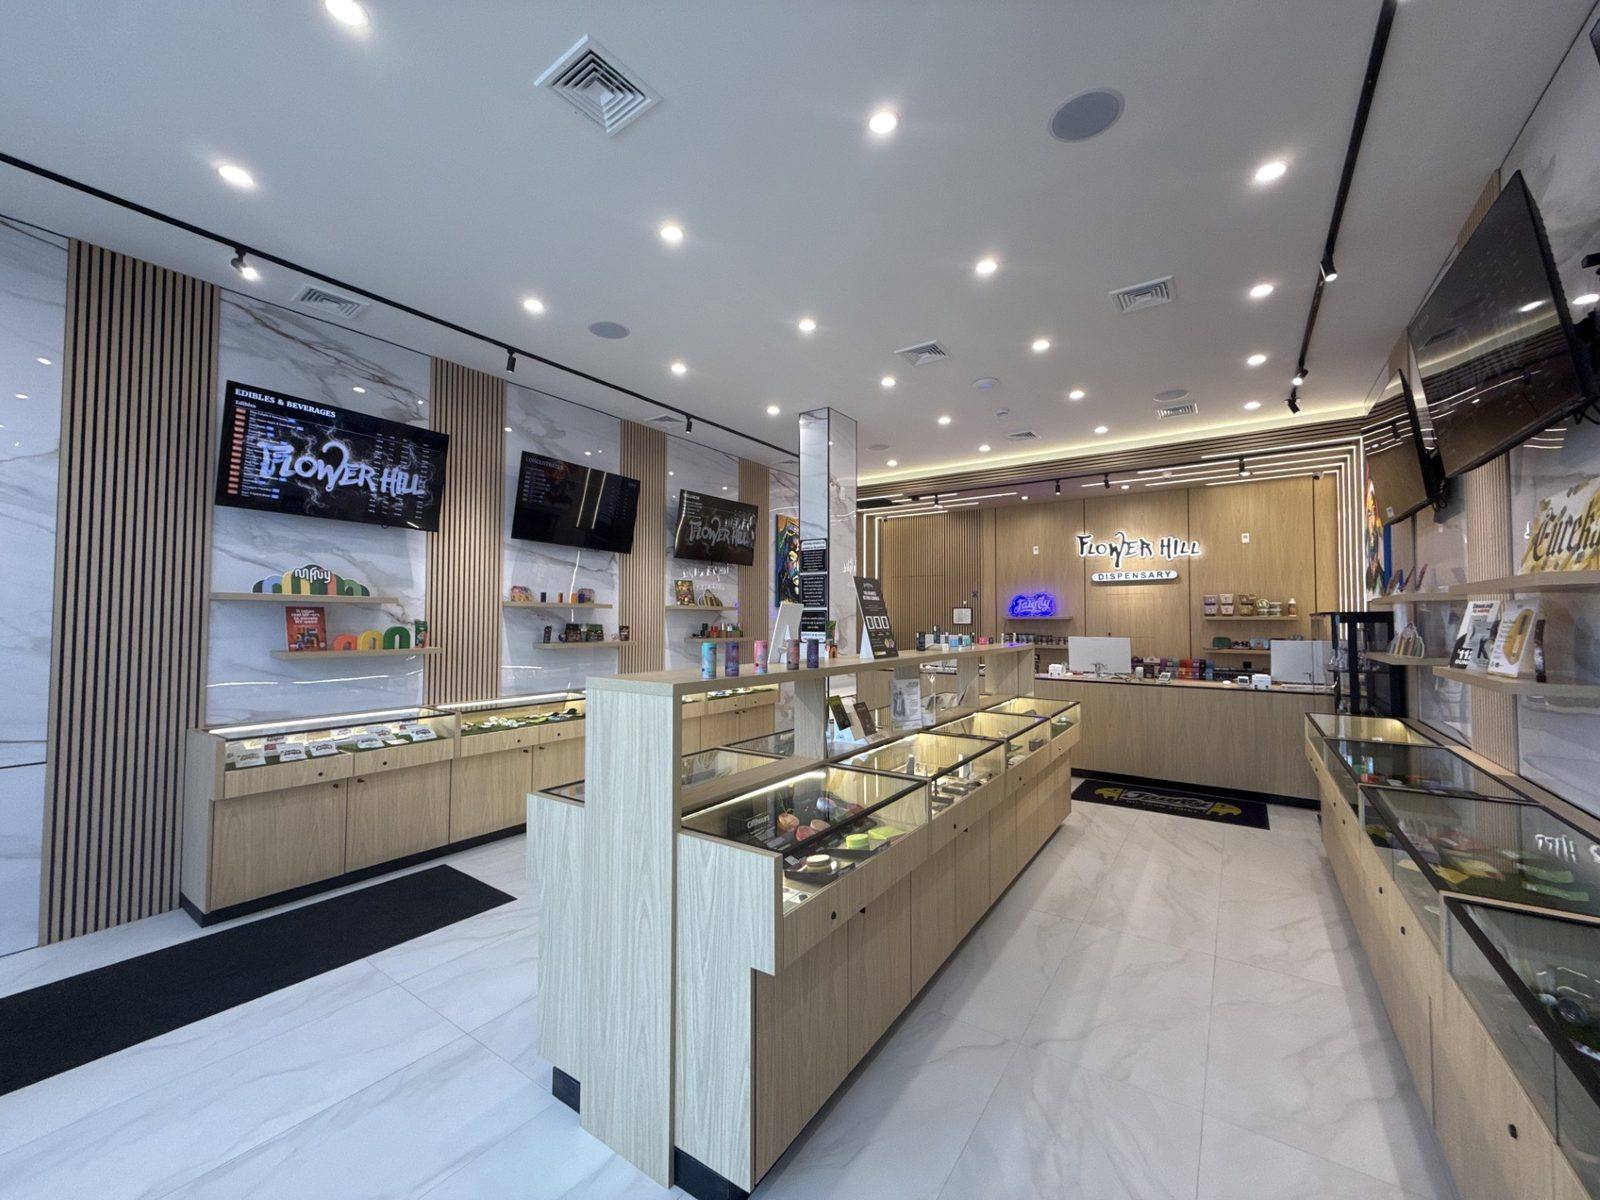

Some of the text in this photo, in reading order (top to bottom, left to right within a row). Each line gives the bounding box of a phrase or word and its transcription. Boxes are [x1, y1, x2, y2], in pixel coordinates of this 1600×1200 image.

[235, 388, 336, 418] EDIBLES & BEVERAGES
[380, 467, 425, 497] HILL
[1160, 538, 1199, 558] HILL
[1098, 571, 1171, 581] DISPENSARY
